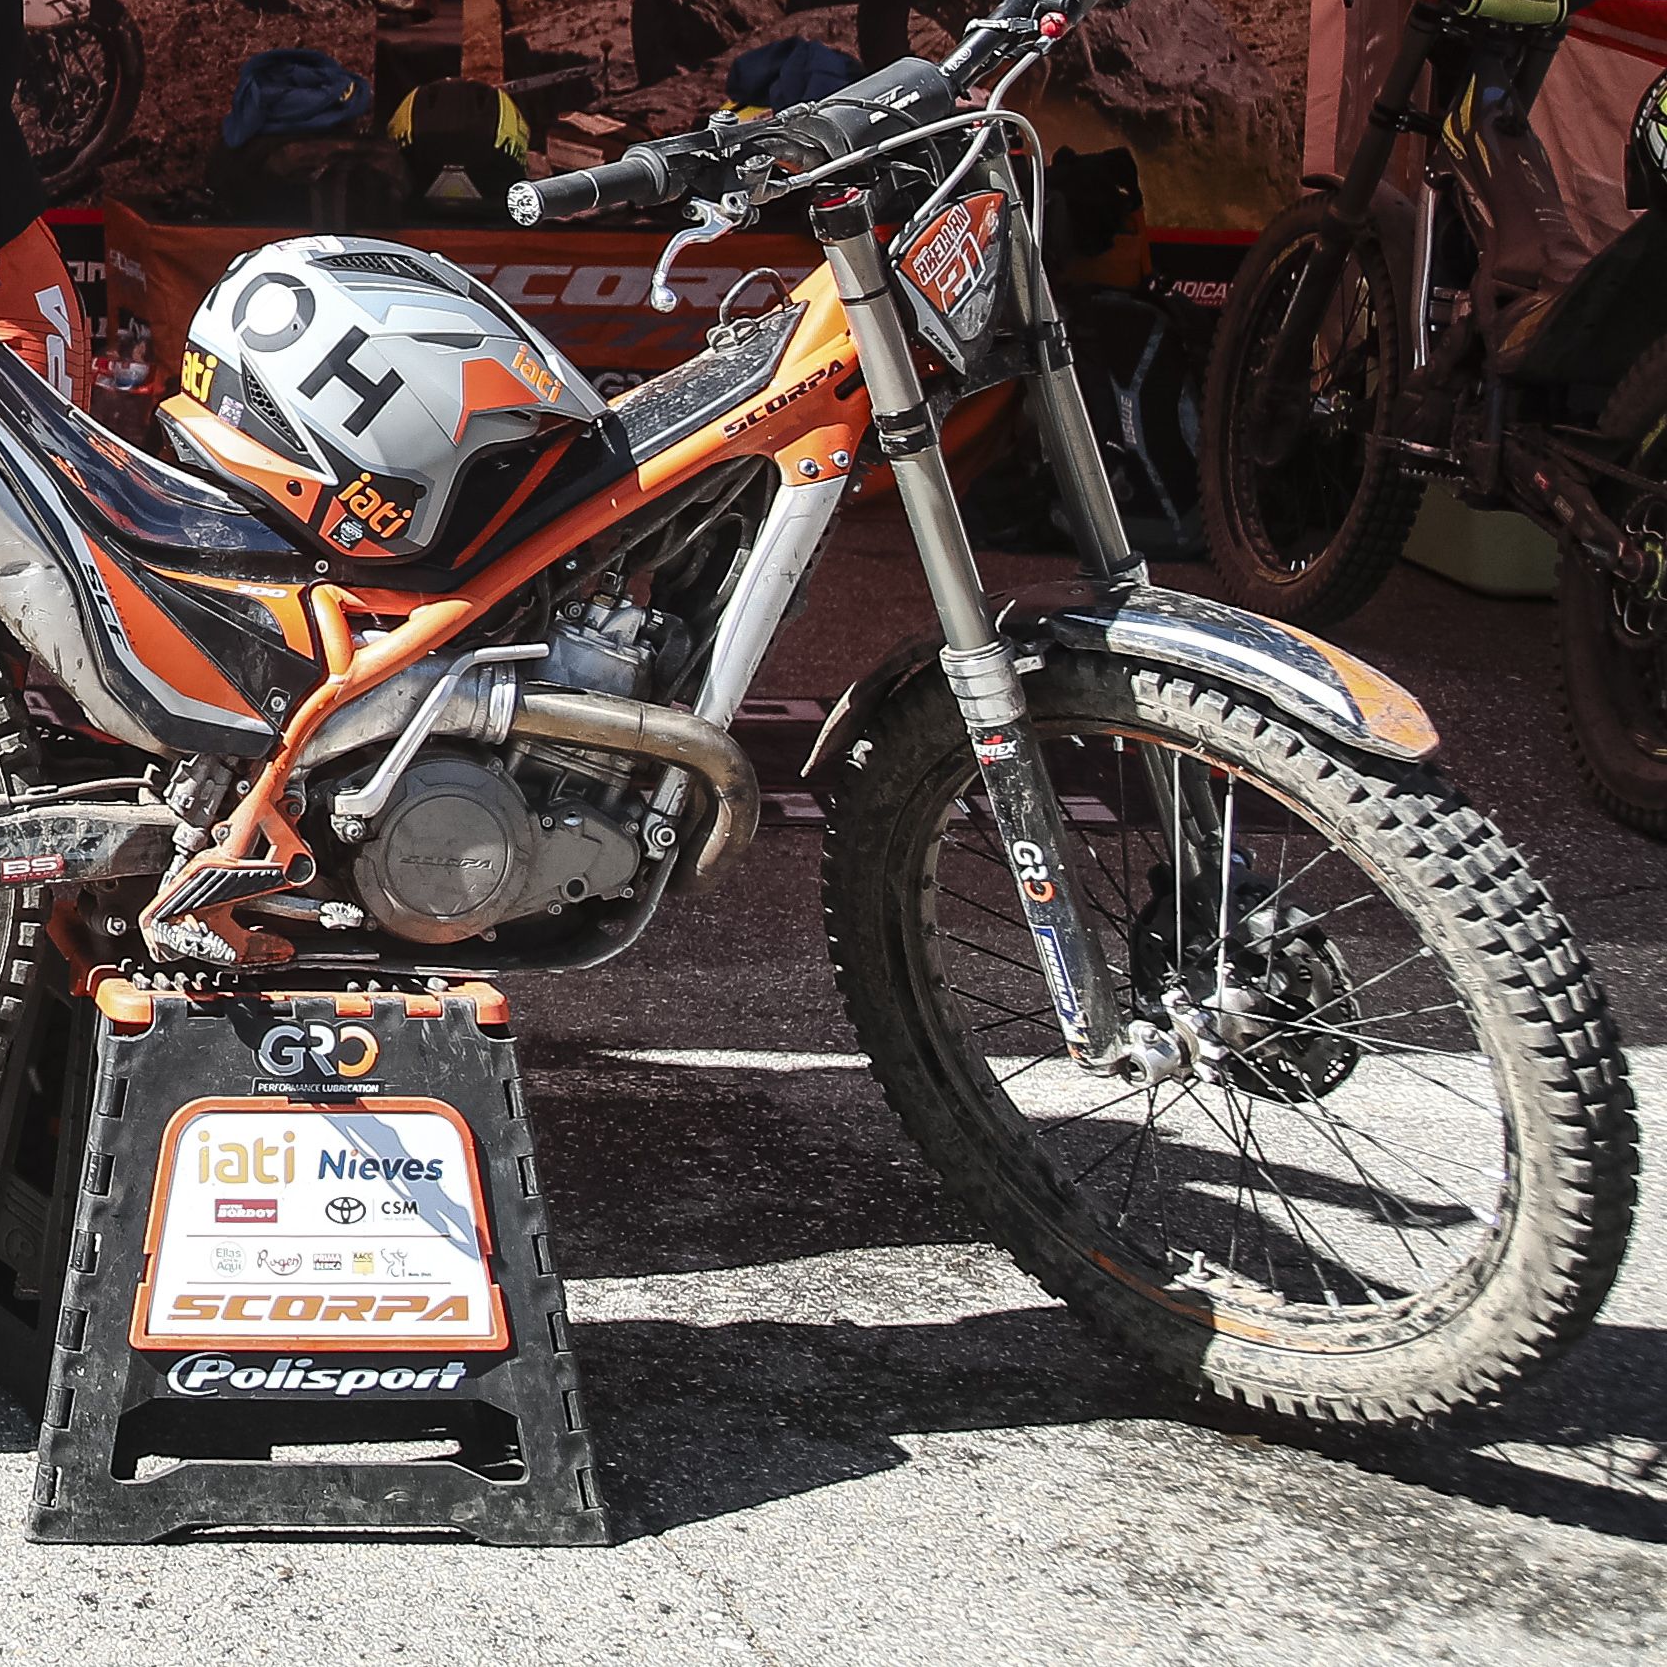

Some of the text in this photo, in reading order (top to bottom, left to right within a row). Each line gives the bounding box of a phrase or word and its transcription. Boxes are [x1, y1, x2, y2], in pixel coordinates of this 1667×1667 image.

[181, 348, 220, 404] ati
[510, 344, 564, 404] iati
[723, 359, 846, 440] SCORPA
[337, 470, 414, 540] iati
[2, 857, 60, 877] BS
[258, 1082, 379, 1094] PERFORMANCE LUBRICATION
[198, 1130, 296, 1185] iati
[317, 1148, 444, 1182] Nieves
[381, 1200, 419, 1216] CSM
[215, 1246, 242, 1259] Ellas
[166, 1294, 470, 1322] SCORPA
[166, 1351, 467, 1397] Polisport
